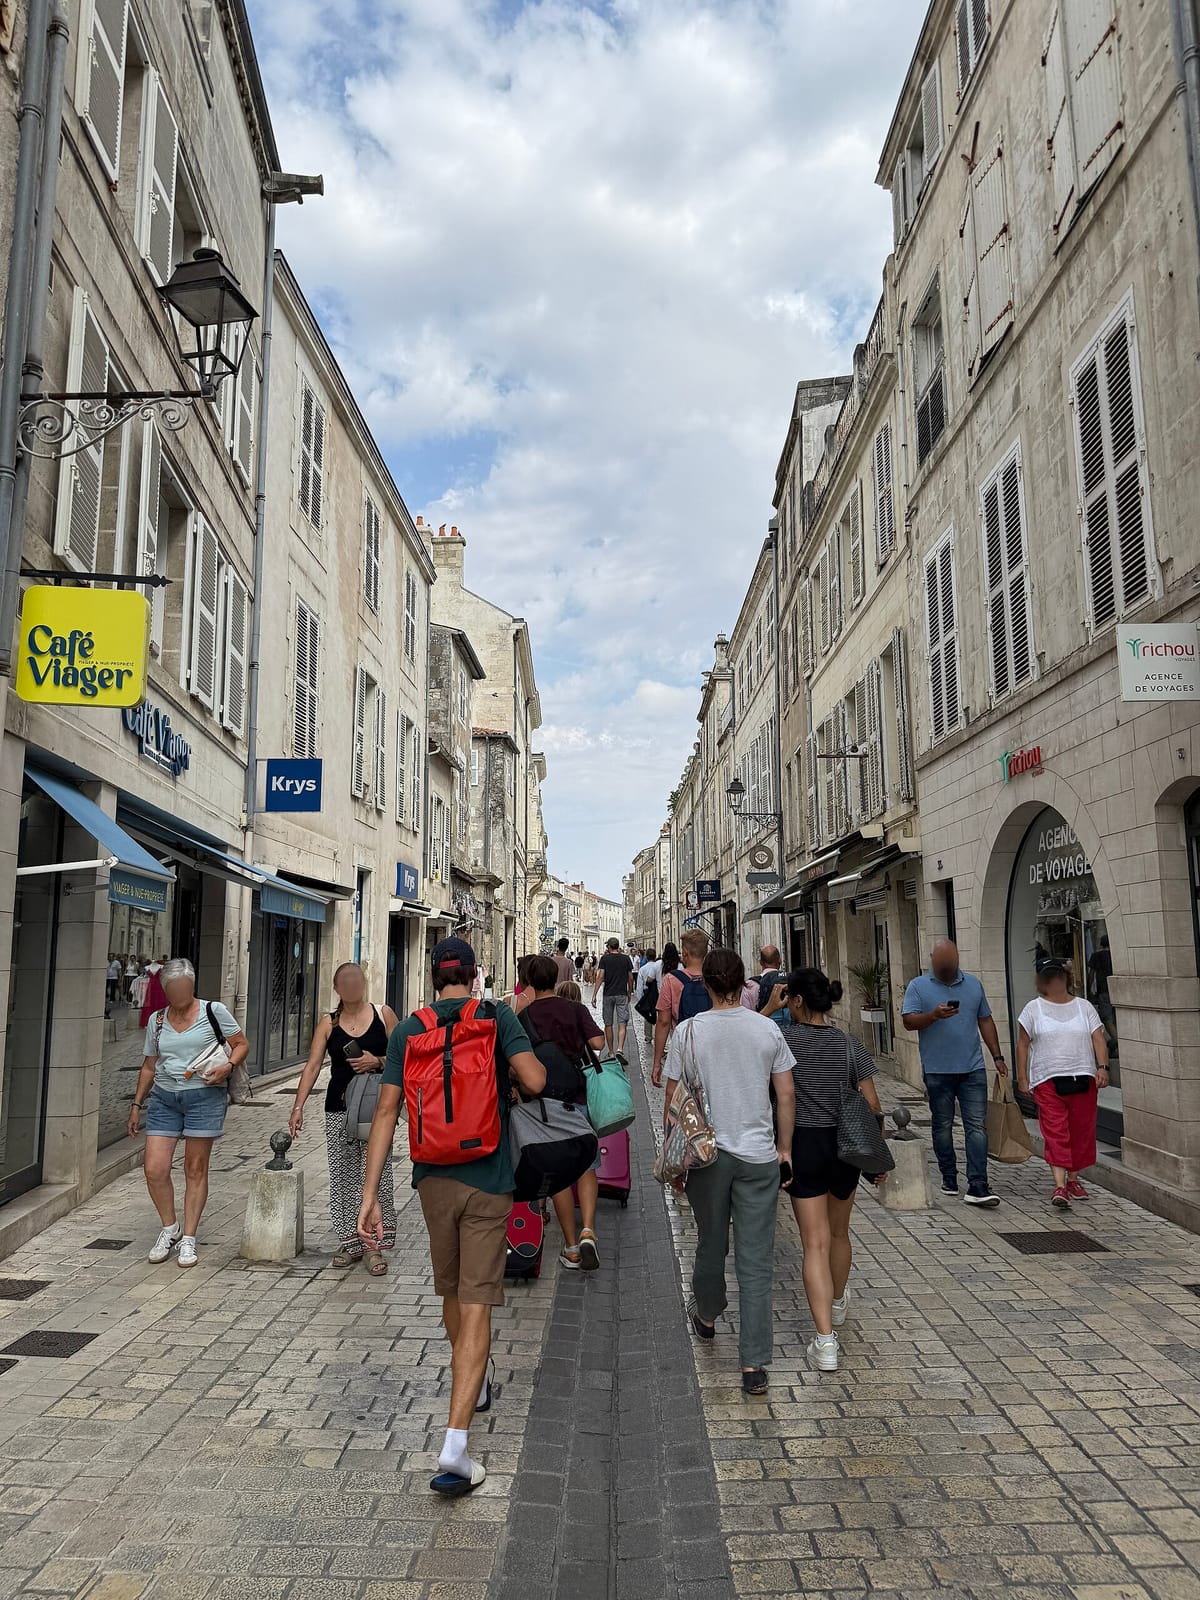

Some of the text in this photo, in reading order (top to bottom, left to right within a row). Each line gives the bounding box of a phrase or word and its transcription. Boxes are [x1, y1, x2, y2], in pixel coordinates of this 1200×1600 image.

[28, 624, 95, 666] Café
[1142, 642, 1195, 656] richou
[27, 656, 133, 697] Viager
[1151, 684, 1194, 692] VOYAGES
[1008, 745, 1041, 778] richou
[271, 775, 316, 795] Krys
[1029, 863, 1043, 884] DE
